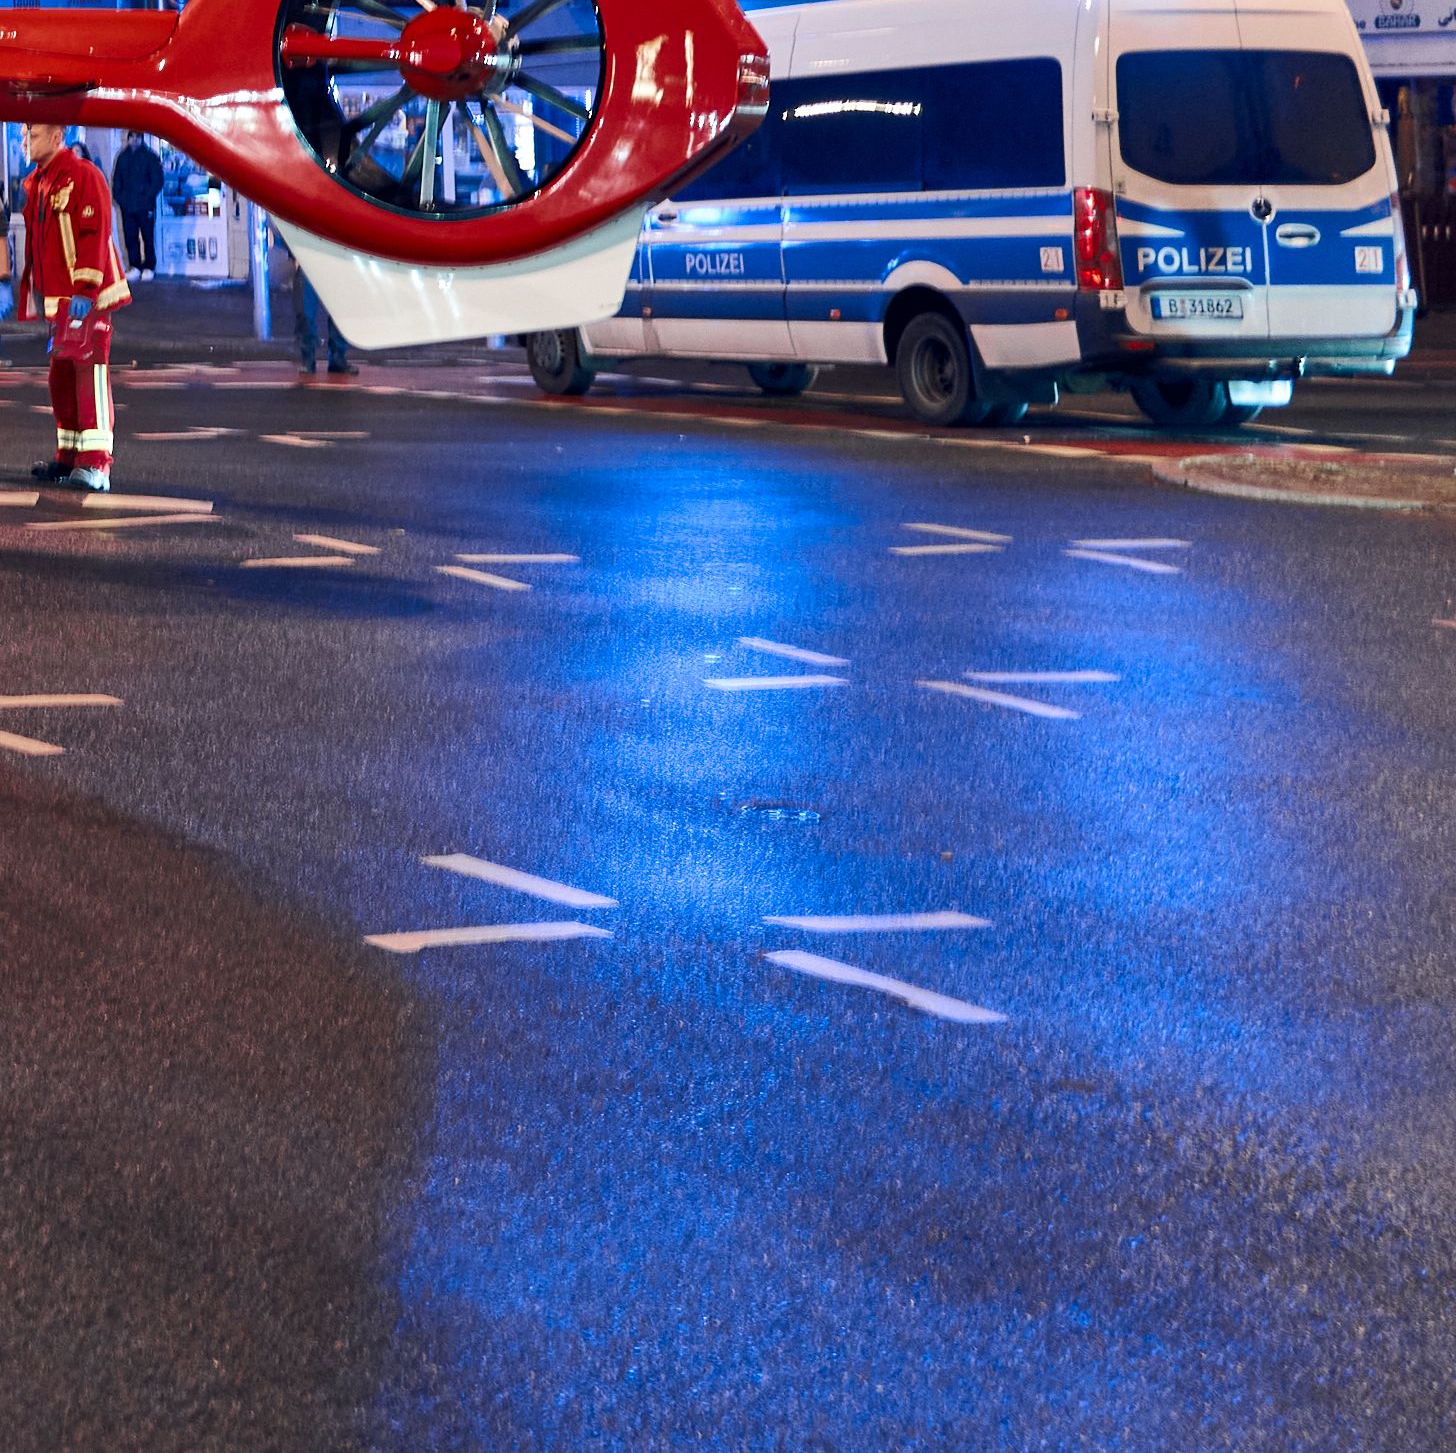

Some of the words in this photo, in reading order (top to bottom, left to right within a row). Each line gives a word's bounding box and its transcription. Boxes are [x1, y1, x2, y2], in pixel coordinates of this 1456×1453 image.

[685, 253, 745, 275] POLIZEI
[1138, 247, 1252, 273] POLIZEI
[1169, 299, 1179, 314] B
[1189, 299, 1233, 314] 31862
